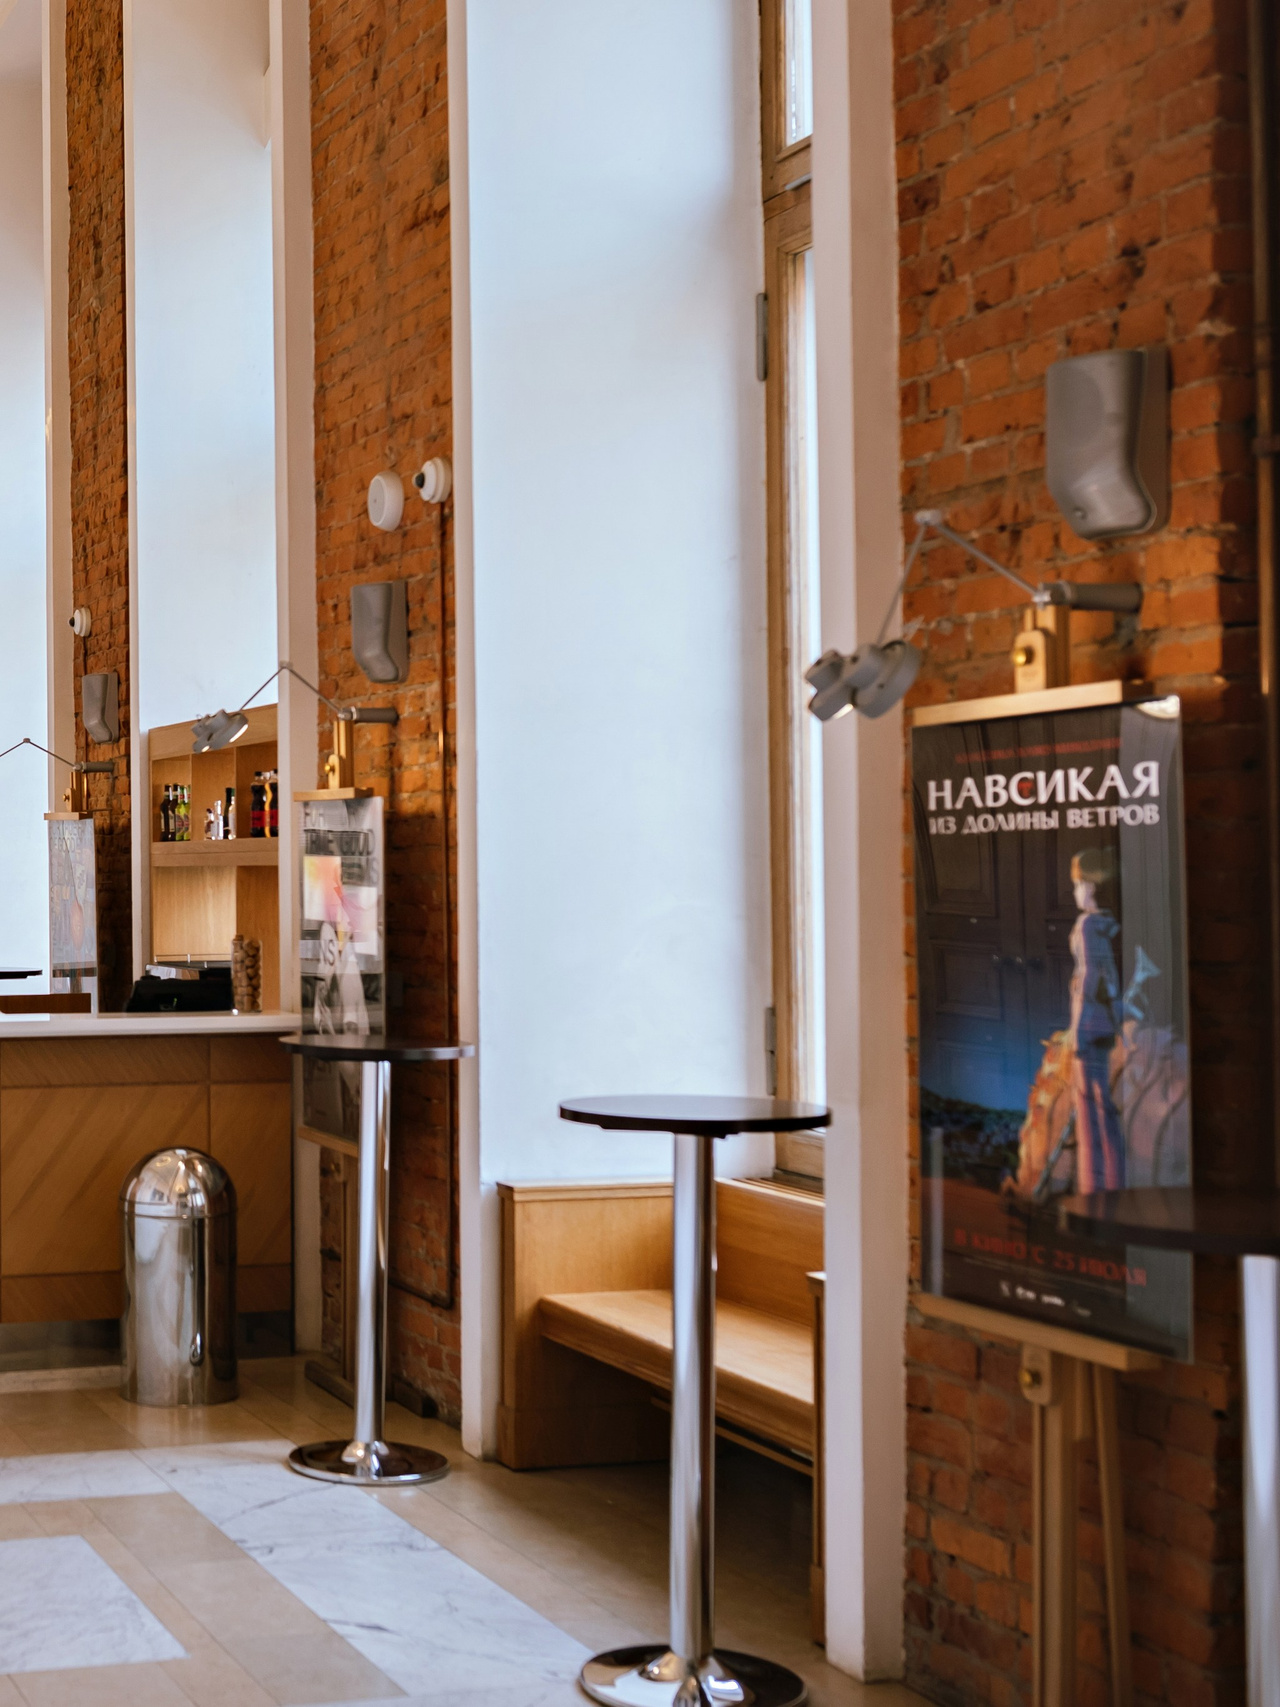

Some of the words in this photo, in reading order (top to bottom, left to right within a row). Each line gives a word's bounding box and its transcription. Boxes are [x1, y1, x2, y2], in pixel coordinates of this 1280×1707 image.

[927, 760, 1160, 811] НАВСИКАЯ
[929, 816, 957, 835] ИЗ
[961, 809, 1060, 835] ДОЛИНЫ
[1066, 803, 1161, 829] ВЕТРОВ
[1053, 1250, 1075, 1272] 25
